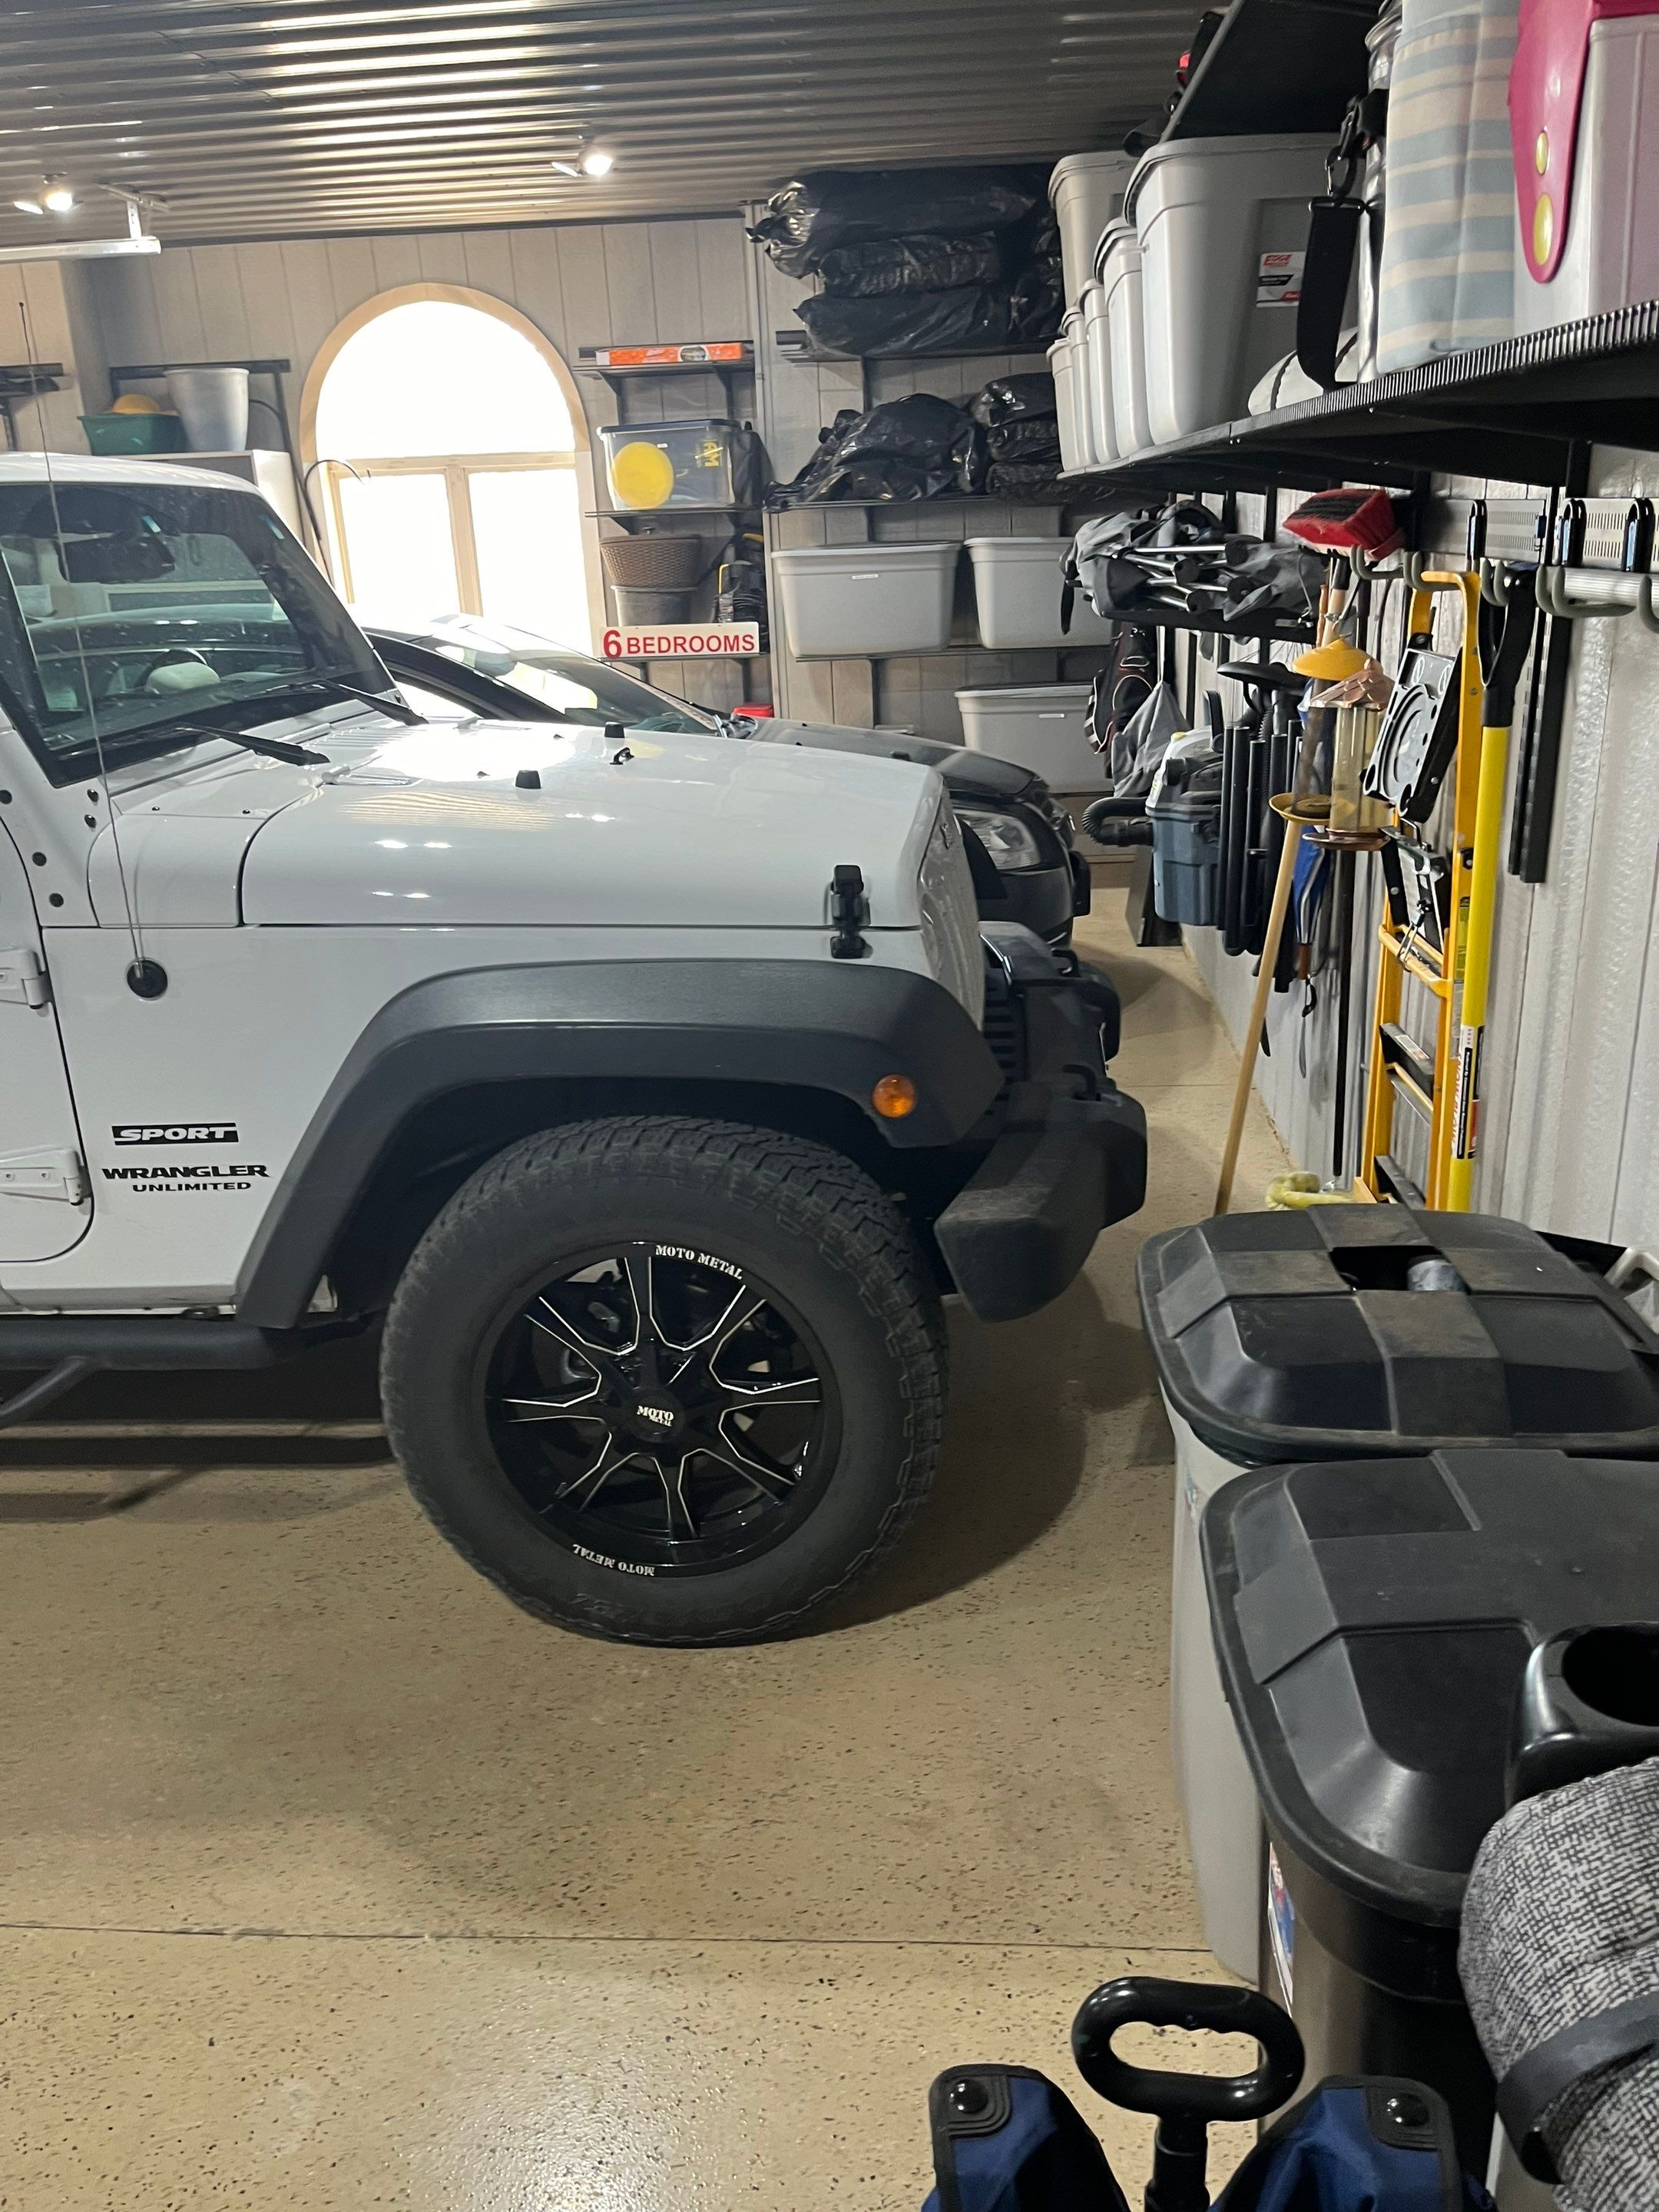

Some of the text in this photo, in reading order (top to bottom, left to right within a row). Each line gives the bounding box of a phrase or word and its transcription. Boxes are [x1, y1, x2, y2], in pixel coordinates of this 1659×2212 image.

[603, 630, 755, 659] 6 BEDROOMS
[114, 1126, 237, 1142] SPORT
[101, 1164, 270, 1180] WRANGLER
[133, 1182, 251, 1192] UNLIMITED
[655, 1245, 743, 1280] MOTO METAL
[637, 1406, 674, 1421] MOTO
[572, 1544, 654, 1576] MOTO METAL
